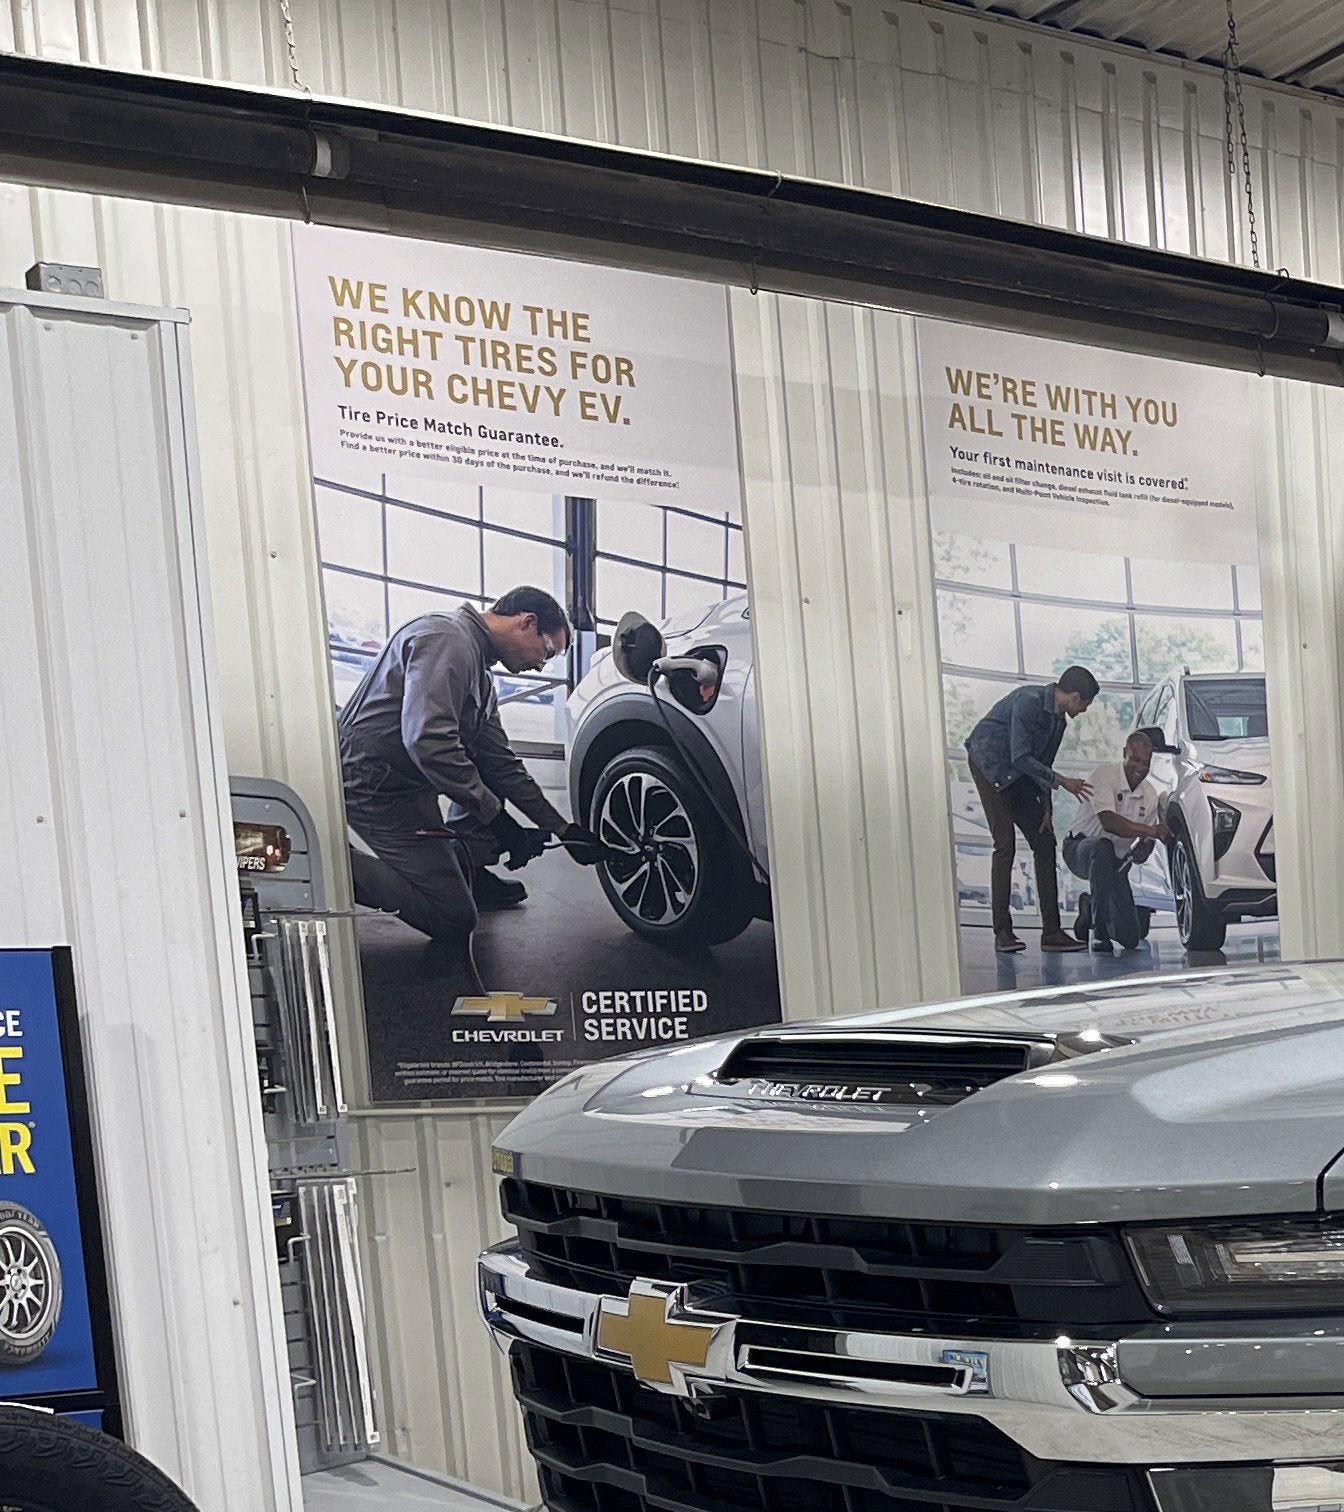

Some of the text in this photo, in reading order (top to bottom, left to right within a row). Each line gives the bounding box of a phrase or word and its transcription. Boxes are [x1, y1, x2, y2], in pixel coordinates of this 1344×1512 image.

[328, 276, 591, 343] WE KNOW THE
[333, 317, 635, 387] RIGHT TIRES FOR
[335, 357, 630, 425] YOUR CHEVY EV.
[945, 367, 1177, 427] WE'RE WITH YOU
[337, 405, 564, 448] Tire Price Match Guarantee.
[949, 404, 1138, 456] ALL THE WAY.
[949, 445, 980, 462] Your
[983, 451, 1011, 468] first
[1015, 459, 1094, 479] maintenance
[1096, 469, 1123, 483] visit
[1125, 472, 1135, 485] is
[581, 990, 708, 1015] CERTIFIED
[451, 1028, 565, 1043] CHEVROLET
[583, 1016, 690, 1042] SERVICE
